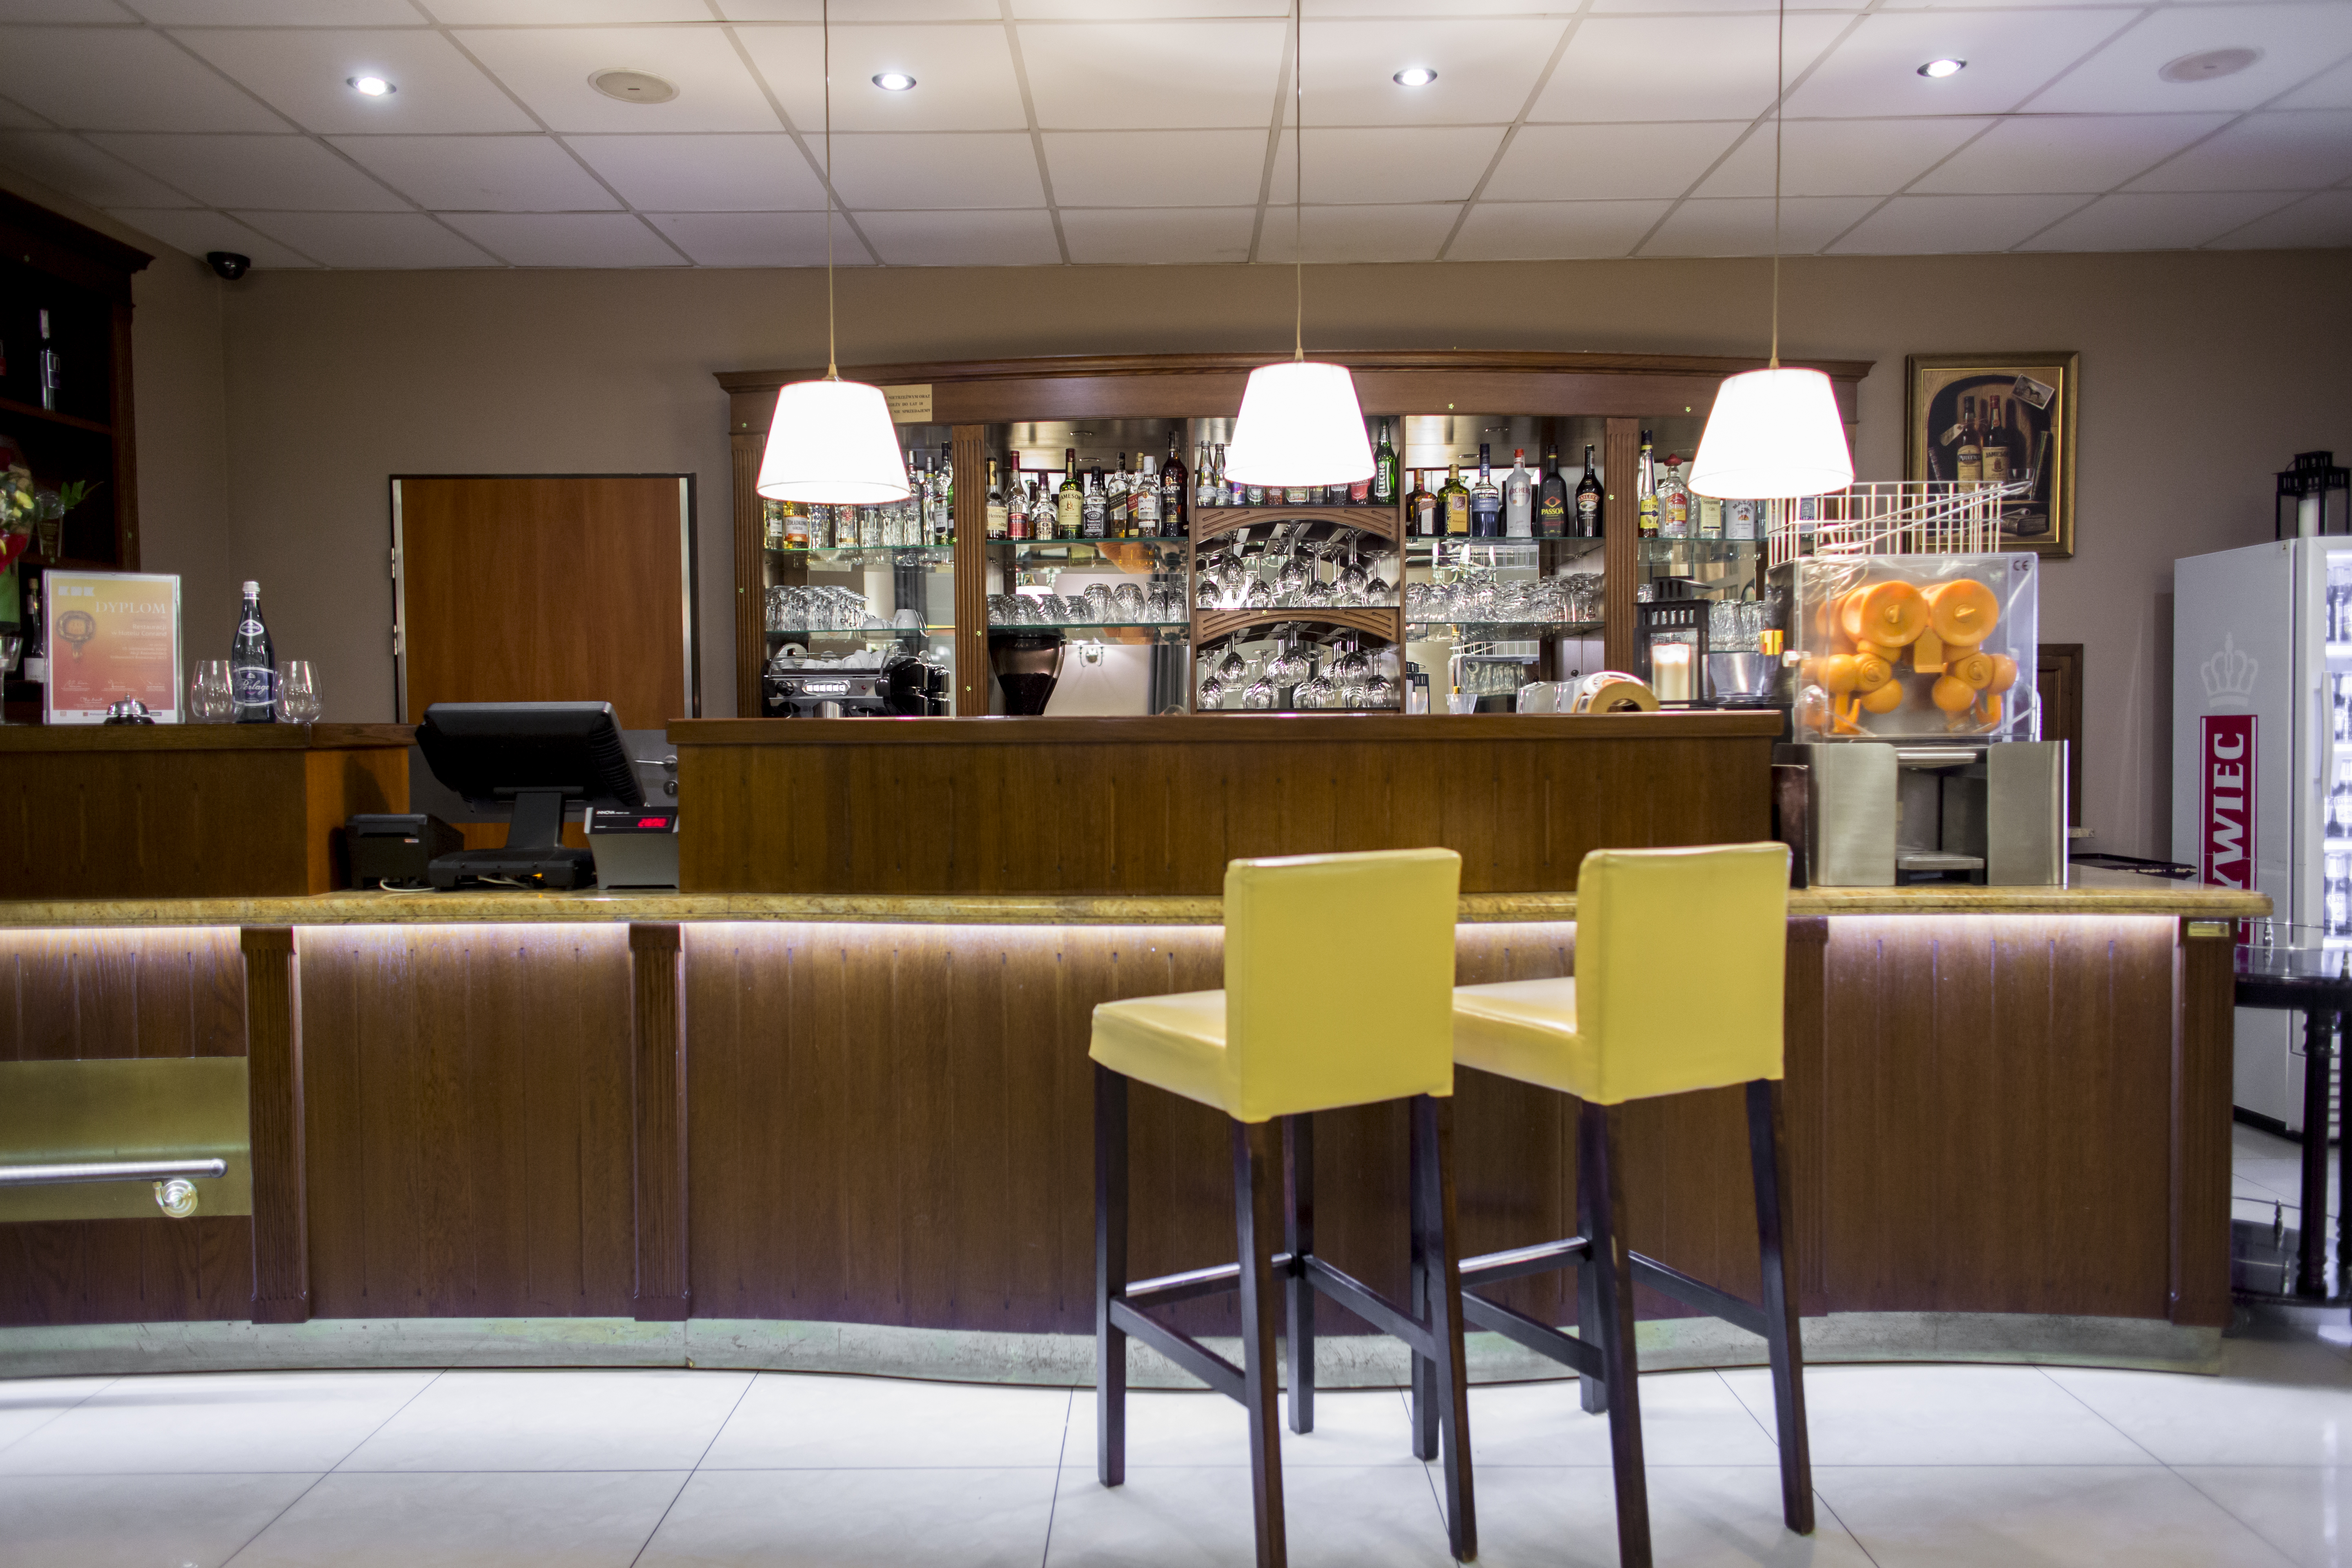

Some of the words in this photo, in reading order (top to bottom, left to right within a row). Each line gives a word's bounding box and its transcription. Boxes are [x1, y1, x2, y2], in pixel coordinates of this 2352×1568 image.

[1059, 493, 1081, 501] JAMESON
[96, 601, 166, 614] DYPLOM
[243, 679, 270, 695] Perlage
[2213, 733, 2244, 889] YWIEC
